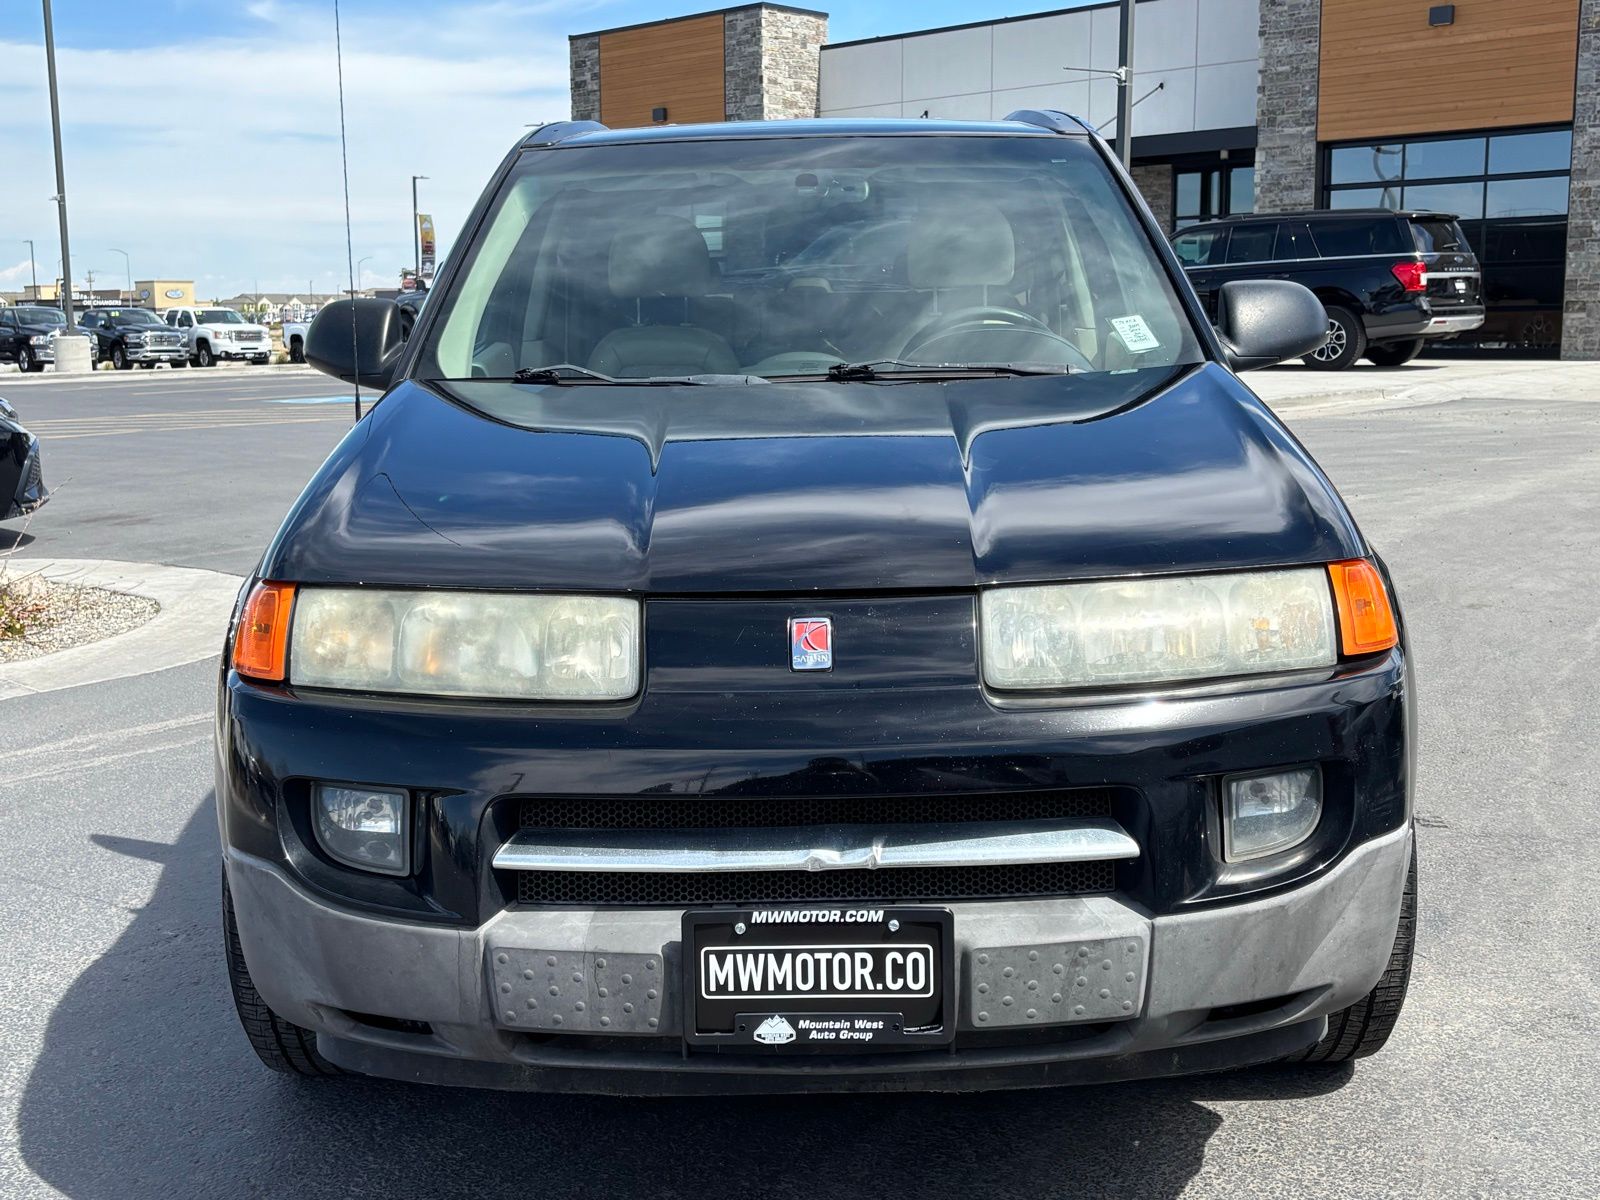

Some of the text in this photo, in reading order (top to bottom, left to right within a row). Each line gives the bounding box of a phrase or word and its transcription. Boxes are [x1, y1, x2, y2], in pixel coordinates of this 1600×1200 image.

[793, 654, 828, 662] SATURN
[751, 910, 884, 924] MWMOTOR.COM
[709, 952, 926, 992] MWMOTOR.CO
[798, 1020, 884, 1029] Mountain West
[809, 1030, 873, 1041] Auto Group
